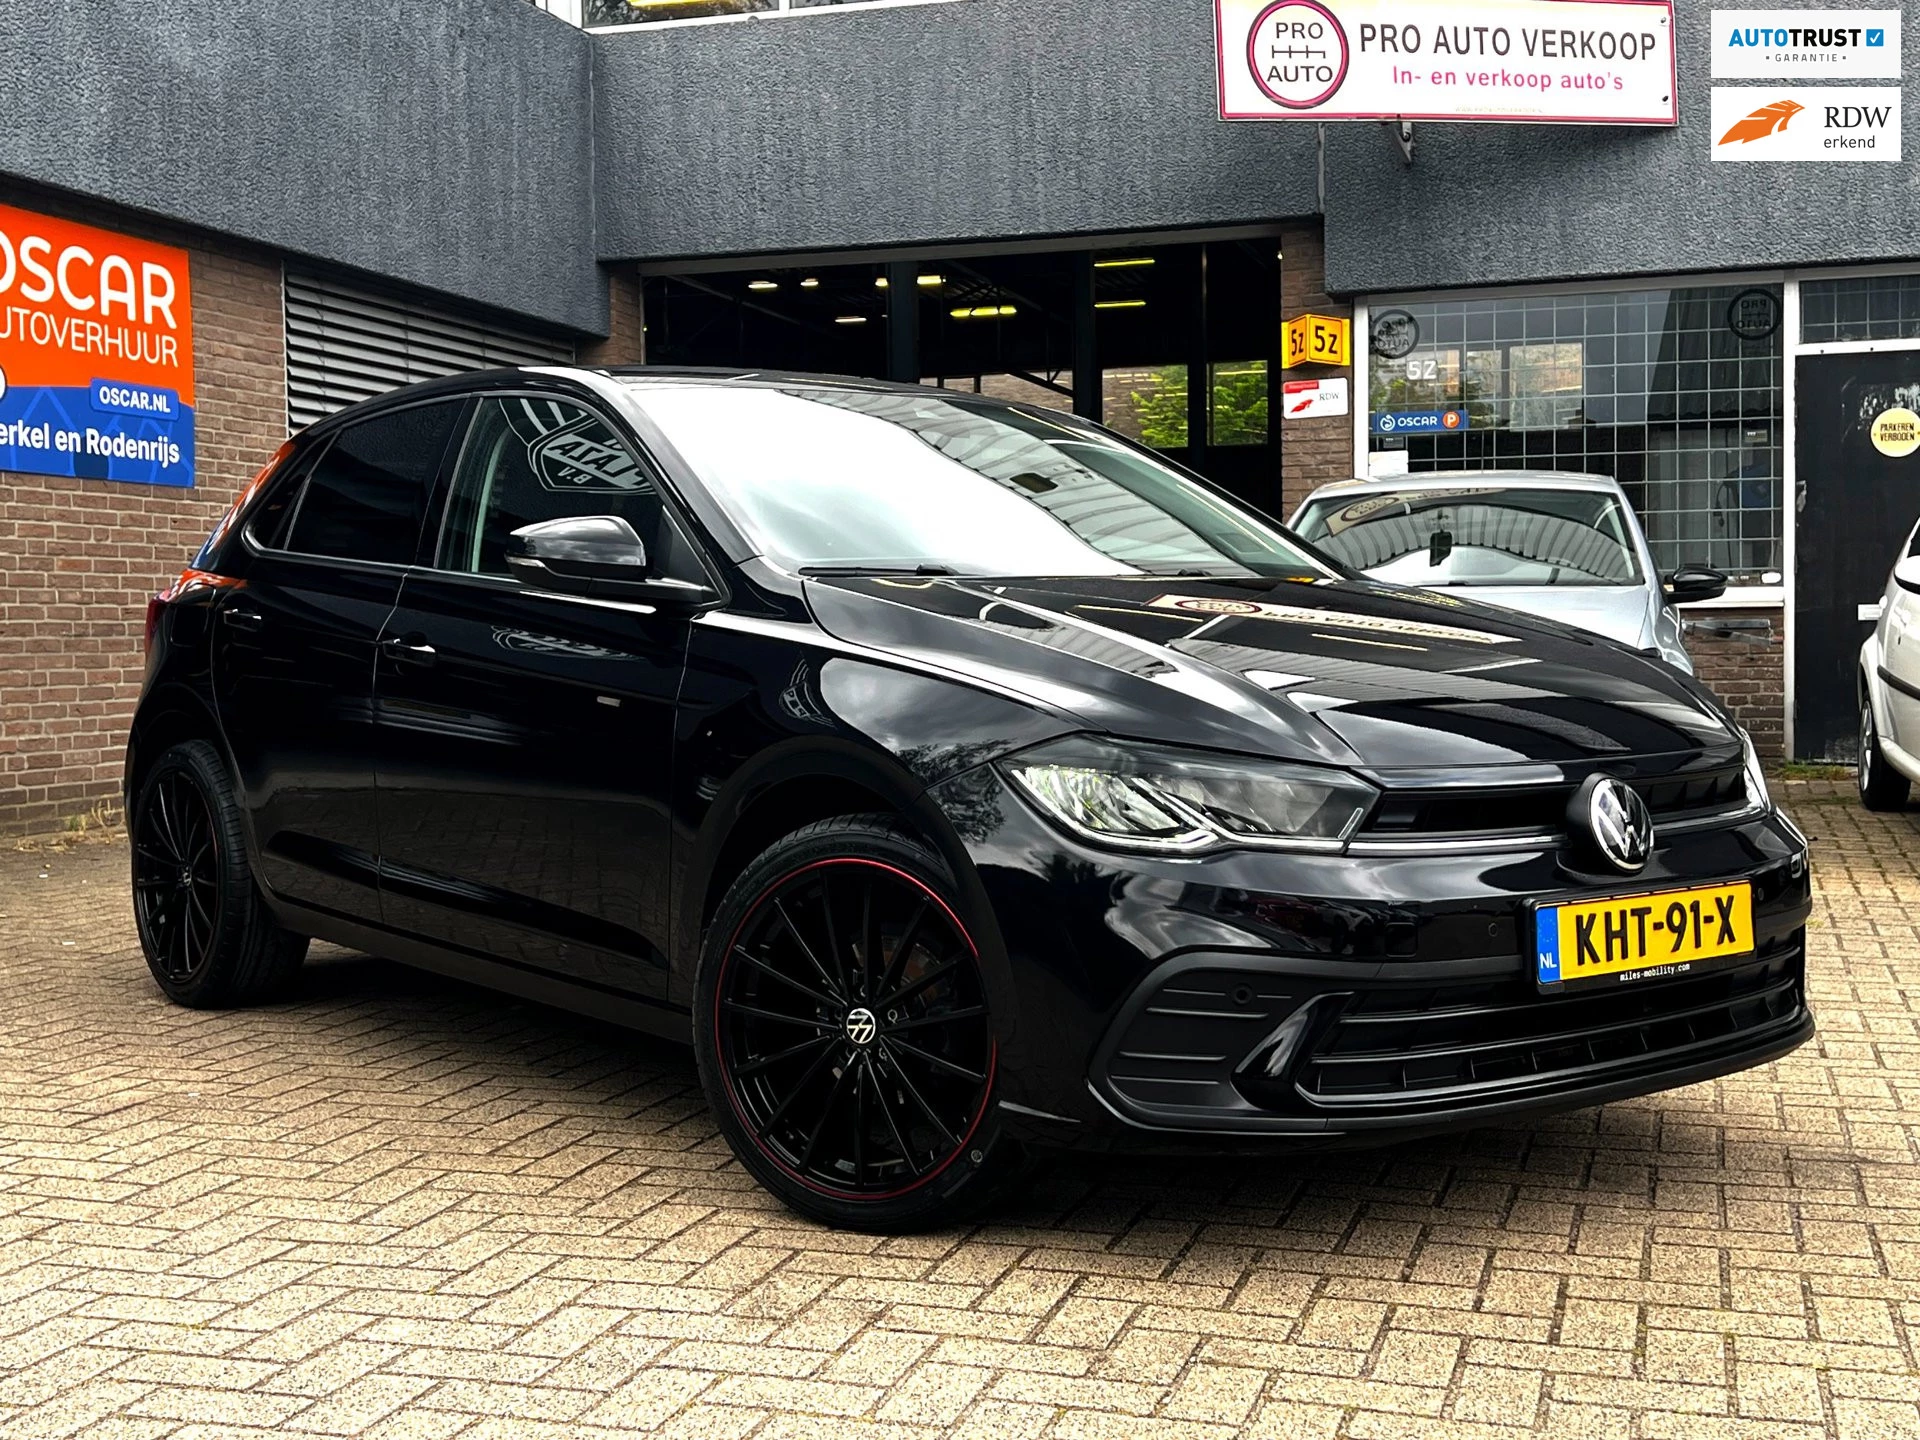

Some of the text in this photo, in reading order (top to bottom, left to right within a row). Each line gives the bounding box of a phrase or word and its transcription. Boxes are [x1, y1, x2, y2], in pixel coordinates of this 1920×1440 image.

[1275, 22, 1324, 40] PRO
[1360, 23, 1657, 61] PRO AUTO VERKOOP
[1266, 65, 1334, 83] AUTO
[1393, 65, 1624, 92] In- en verkoop auto's
[99, 385, 171, 414] OSCAR.NL
[1397, 416, 1438, 427] OSCAR
[1880, 422, 1915, 432] PARKEREN
[1880, 432, 1915, 442] VERBODEN
[54, 430, 81, 454] en
[86, 427, 181, 469] Rodenrijs
[1575, 894, 1736, 966] KHT-91-X
[1539, 952, 1558, 969] NL
[1619, 963, 1690, 982] miles-mobility.com
